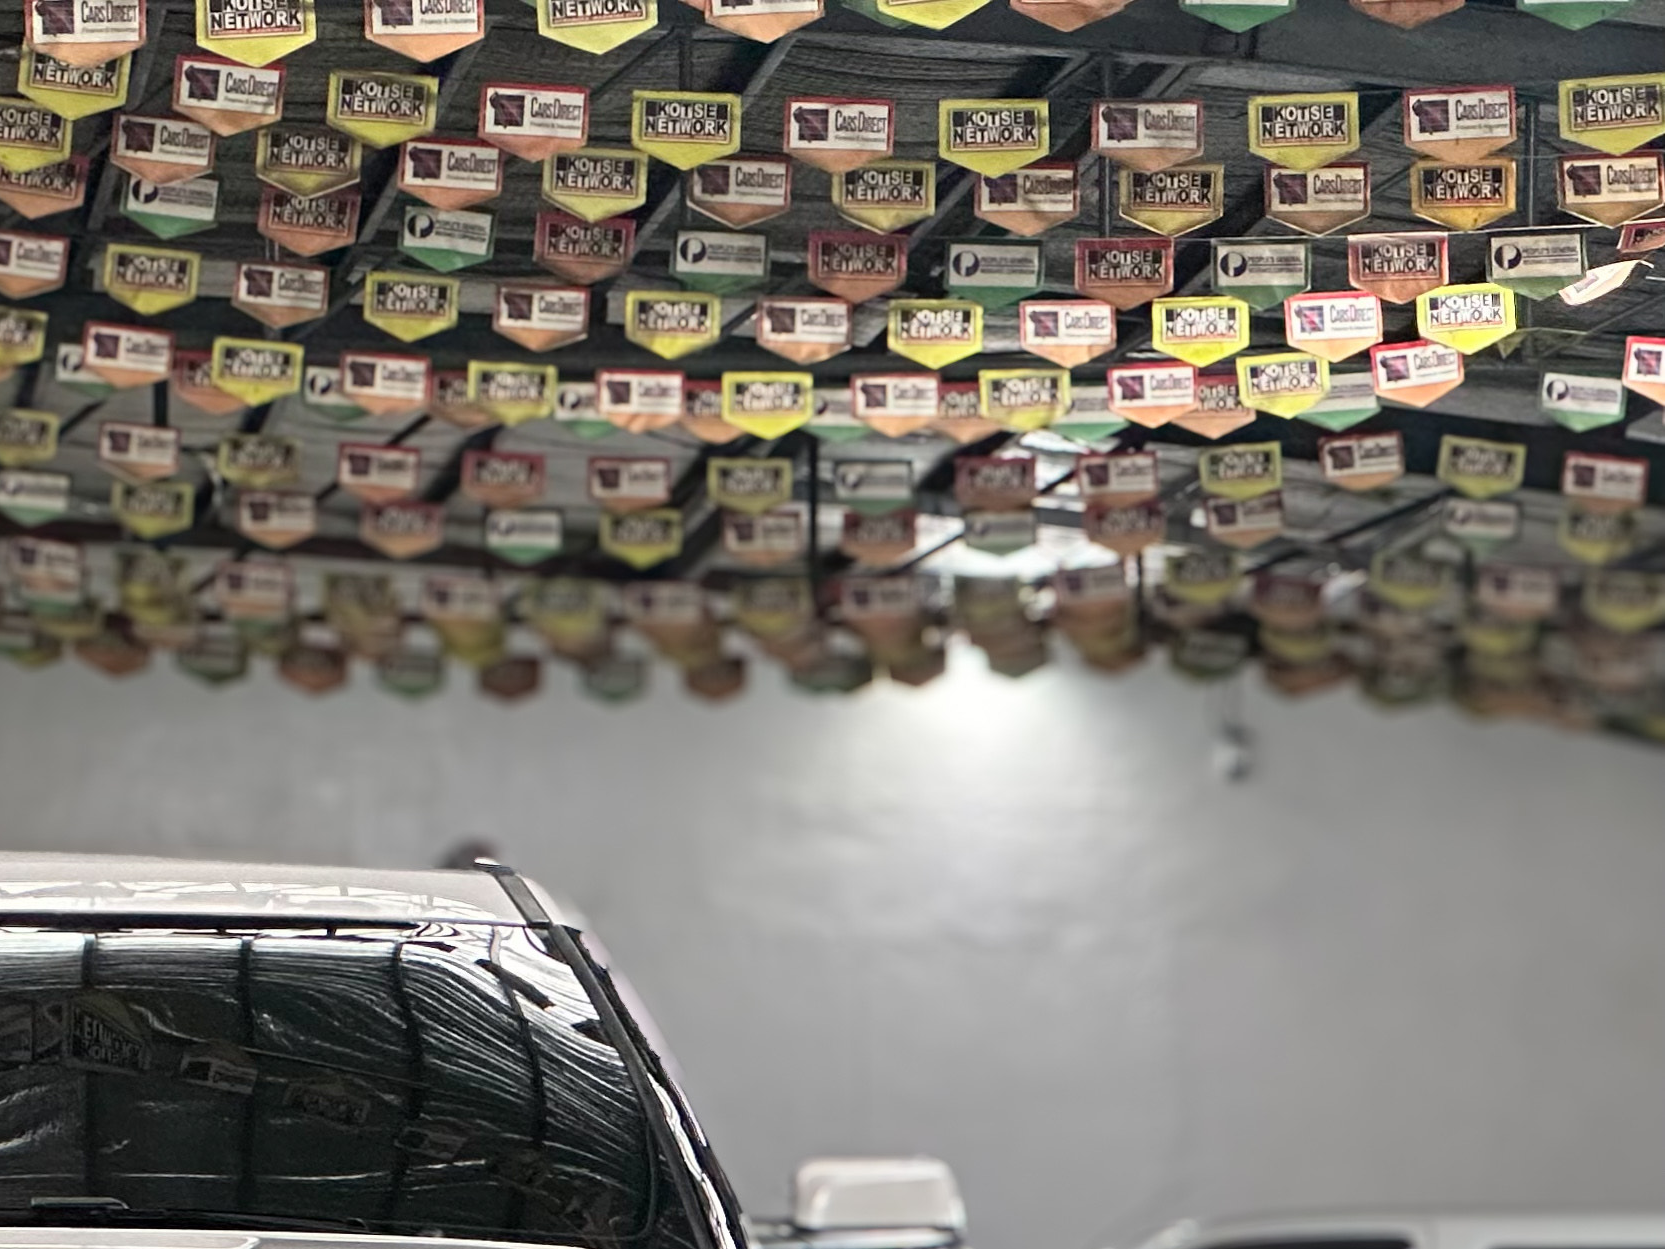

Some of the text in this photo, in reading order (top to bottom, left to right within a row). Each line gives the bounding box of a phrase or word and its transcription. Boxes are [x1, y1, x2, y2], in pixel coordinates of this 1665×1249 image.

[211, 11, 302, 29] NETWORK
[1587, 86, 1647, 104] KOTSE
[659, 103, 717, 119] KOTSE
[966, 110, 1025, 125] KOTSE
[1274, 104, 1334, 121] KOTSE
[1574, 102, 1658, 122] NETWORK
[646, 118, 727, 135] NETWORK
[954, 126, 1036, 143] NETWORK
[1262, 121, 1346, 138] NETWORK
[568, 158, 624, 174] KOTSE
[556, 170, 634, 190] NETWORK
[857, 170, 914, 186] KOTSE
[1144, 173, 1201, 187] KOTSE
[1435, 168, 1491, 183] KOTSE
[846, 186, 922, 201] NETWORK
[1134, 187, 1210, 204] NETWORK
[1425, 183, 1502, 199] NETWORK
[1372, 244, 1426, 258] KOTSE
[1363, 258, 1436, 273] NETWORK
[1441, 293, 1491, 309] KOTSE
[1431, 308, 1502, 324] NETWORK
